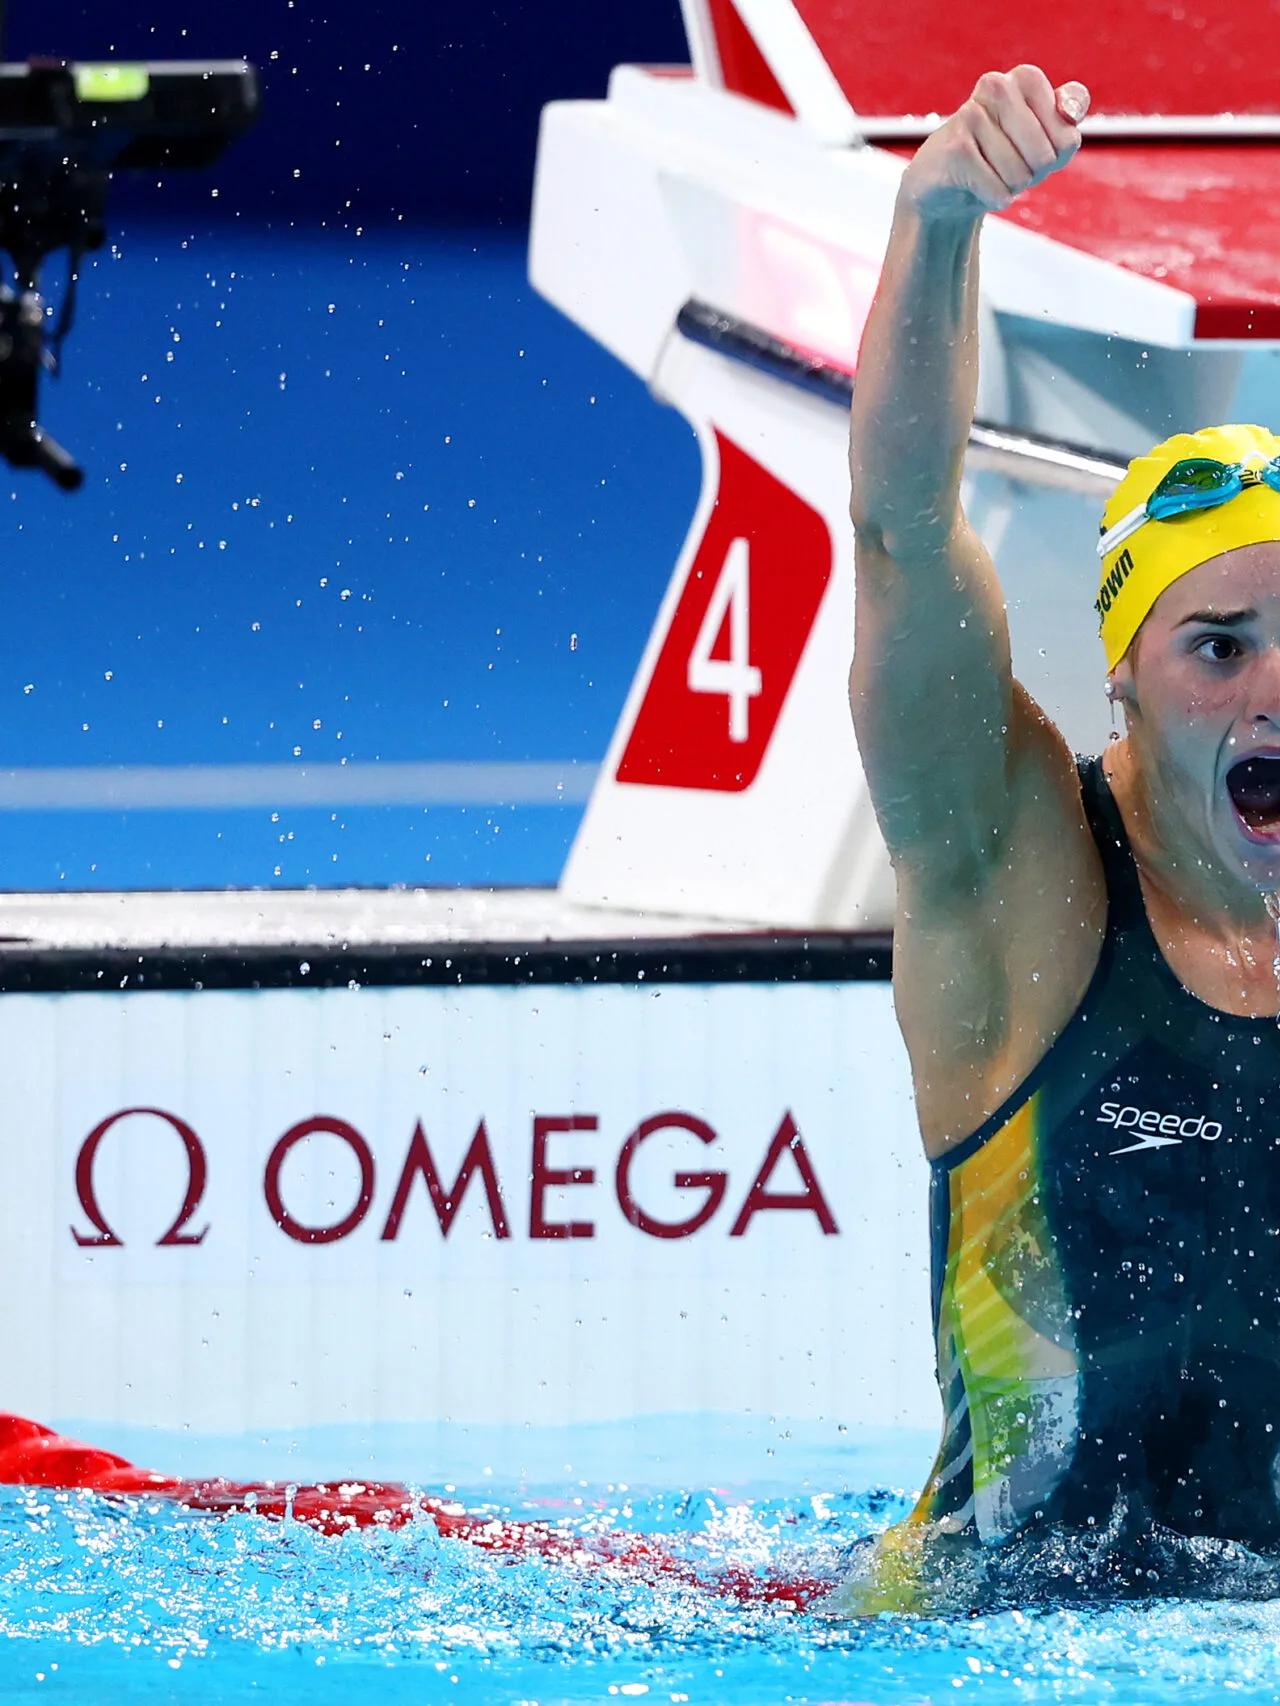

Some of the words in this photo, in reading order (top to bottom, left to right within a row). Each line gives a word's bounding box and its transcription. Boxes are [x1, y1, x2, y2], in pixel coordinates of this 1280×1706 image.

[687, 536, 762, 743] 4
[264, 1109, 841, 1244] OMEGA
[1096, 1102, 1223, 1141] speedo
